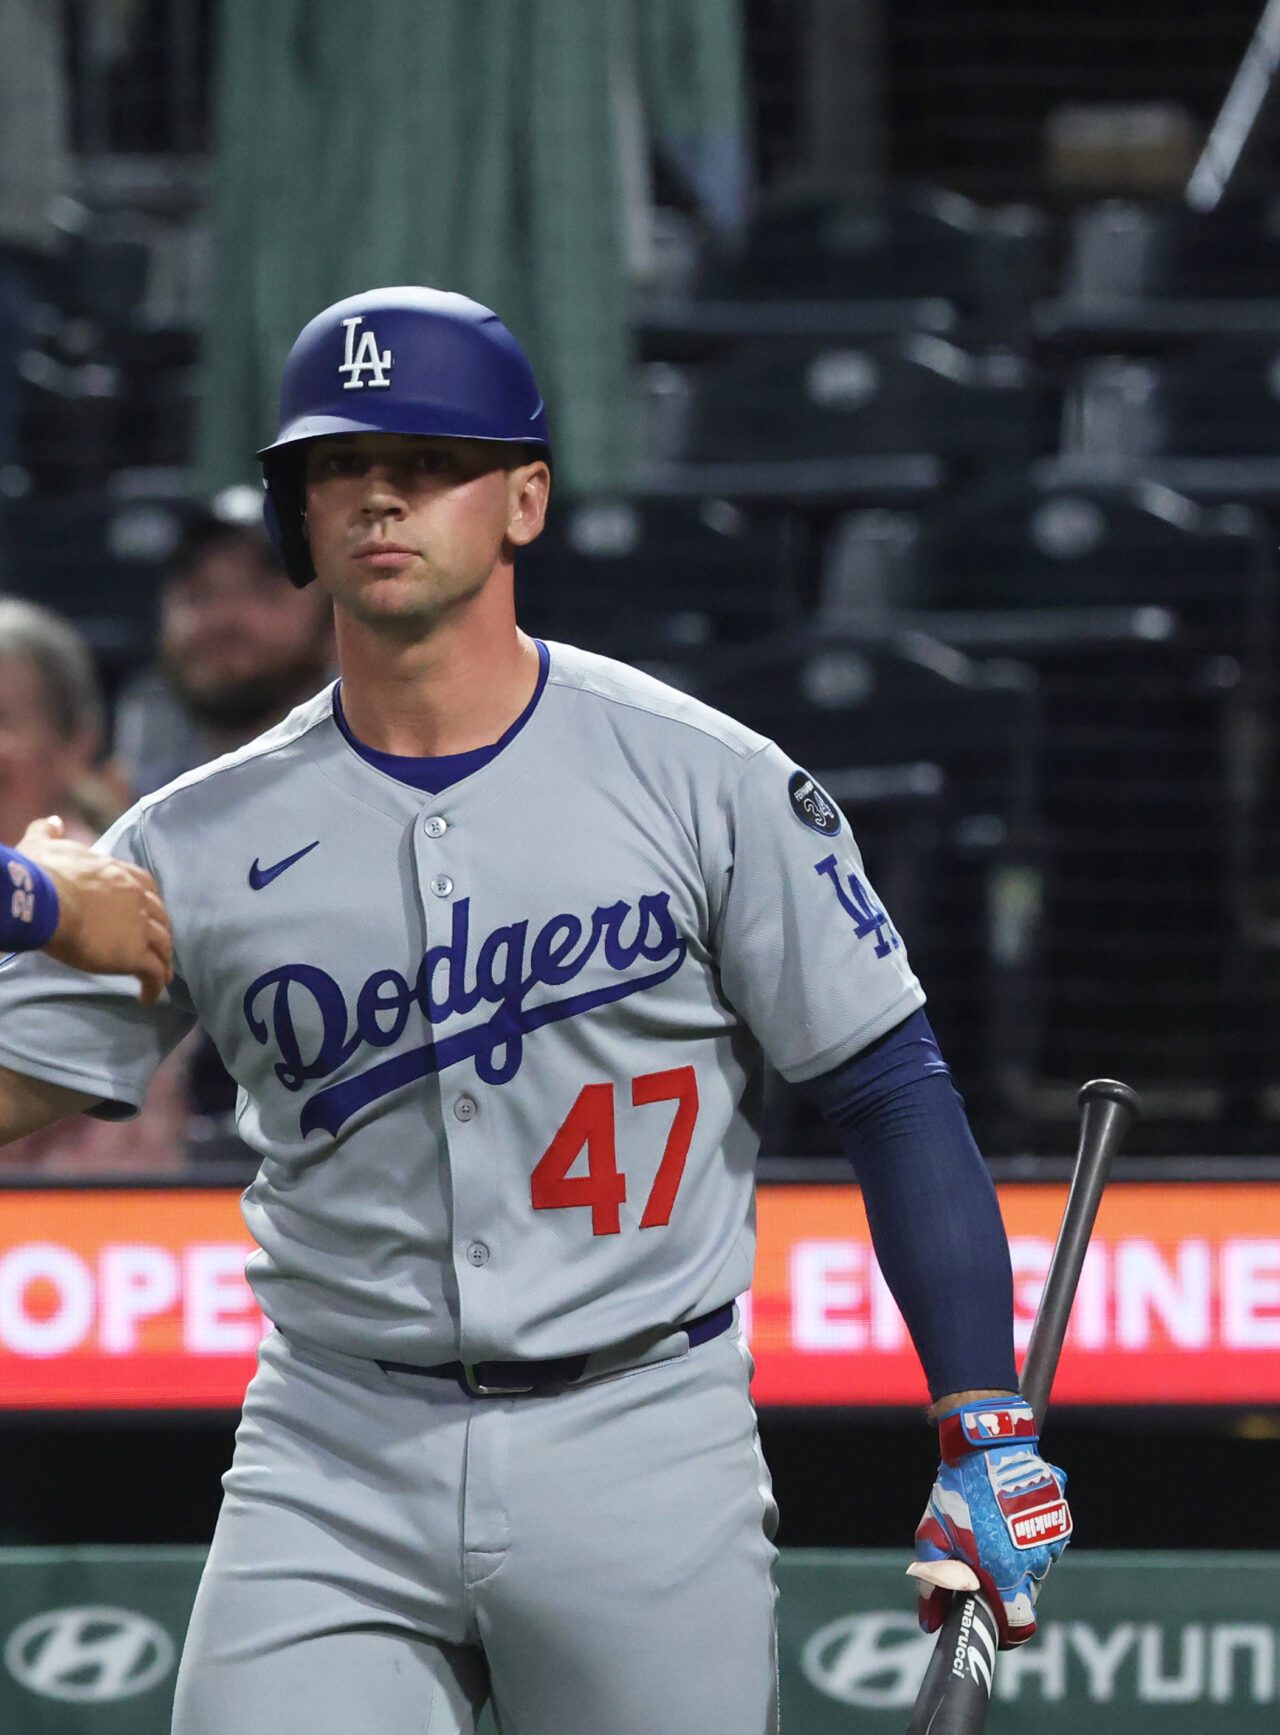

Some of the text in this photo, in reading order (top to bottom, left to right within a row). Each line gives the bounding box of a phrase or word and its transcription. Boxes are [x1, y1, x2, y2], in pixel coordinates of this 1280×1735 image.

[338, 316, 393, 389] LA
[803, 790, 835, 827] 34
[814, 853, 900, 960] LA
[243, 890, 687, 1092] Dodgers
[530, 1064, 699, 1236] 47
[951, 1598, 976, 1680] marucci
